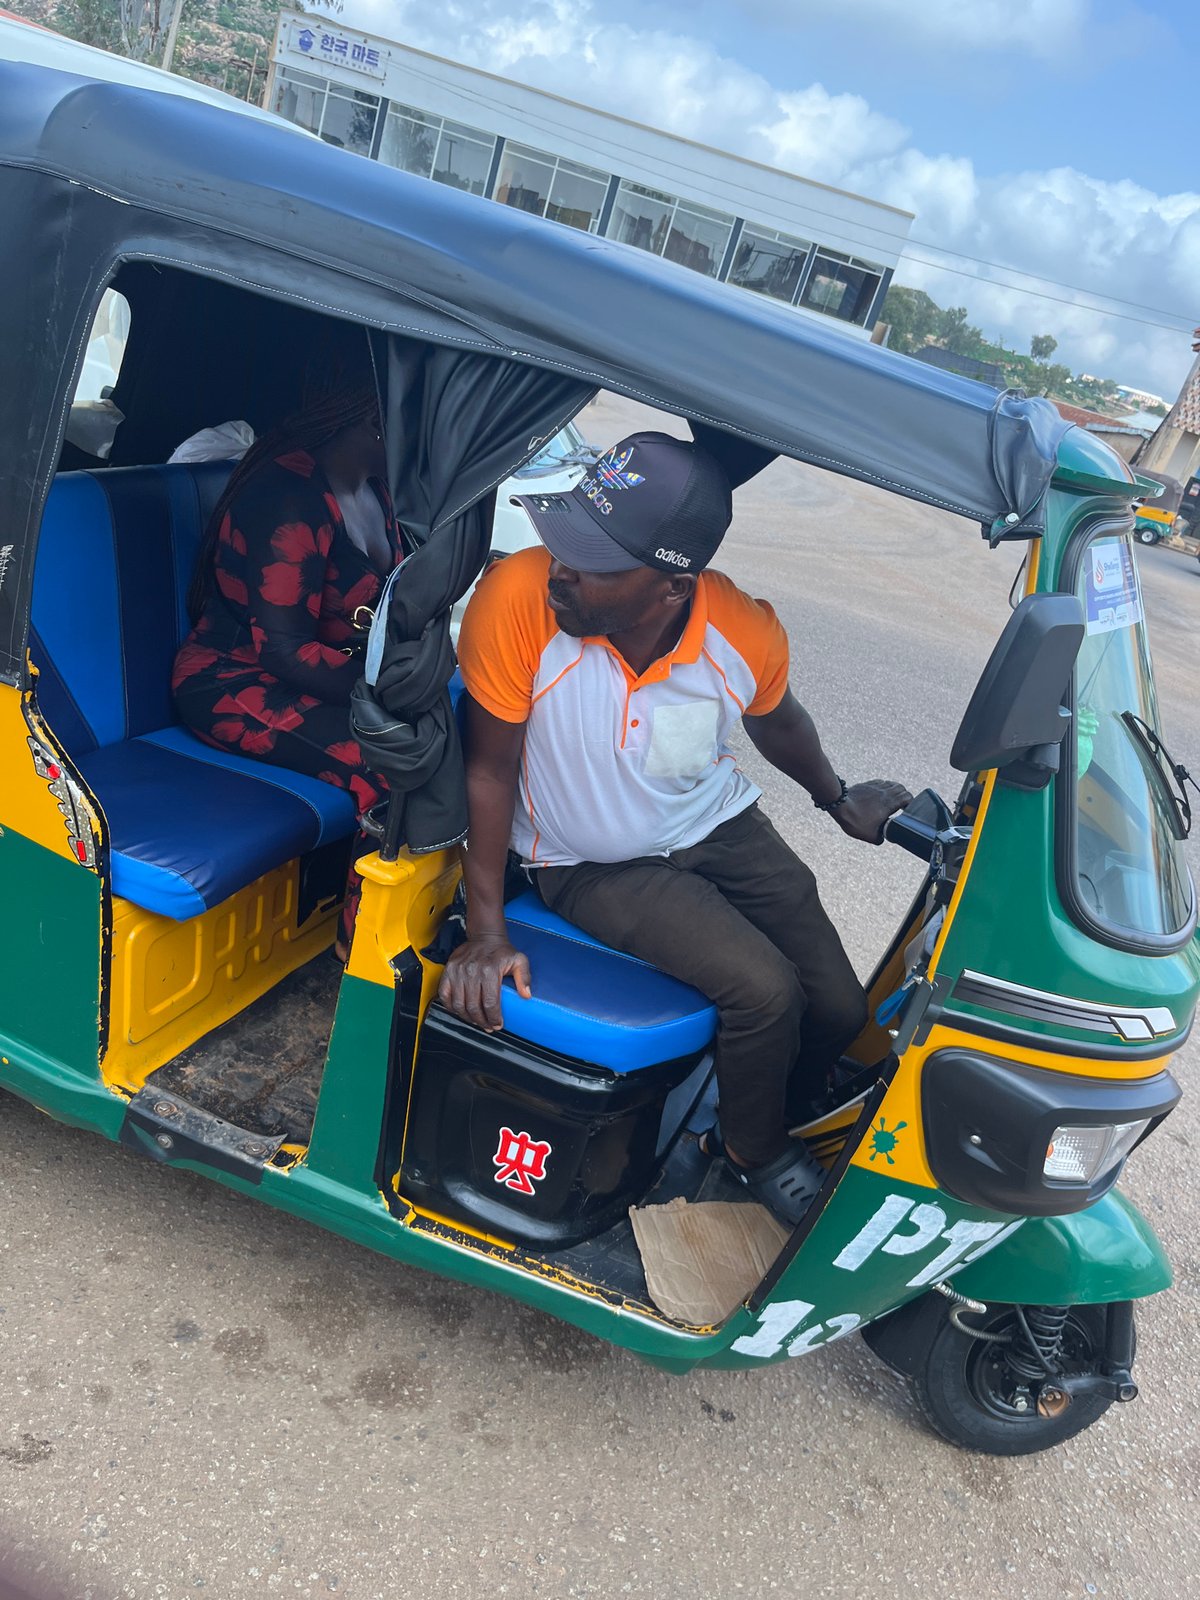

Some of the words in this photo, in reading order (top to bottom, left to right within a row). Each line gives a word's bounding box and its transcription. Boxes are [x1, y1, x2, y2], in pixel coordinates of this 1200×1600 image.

[320, 34, 349, 57] 한국
[351, 44, 380, 67] 마트
[655, 547, 691, 568] adidas
